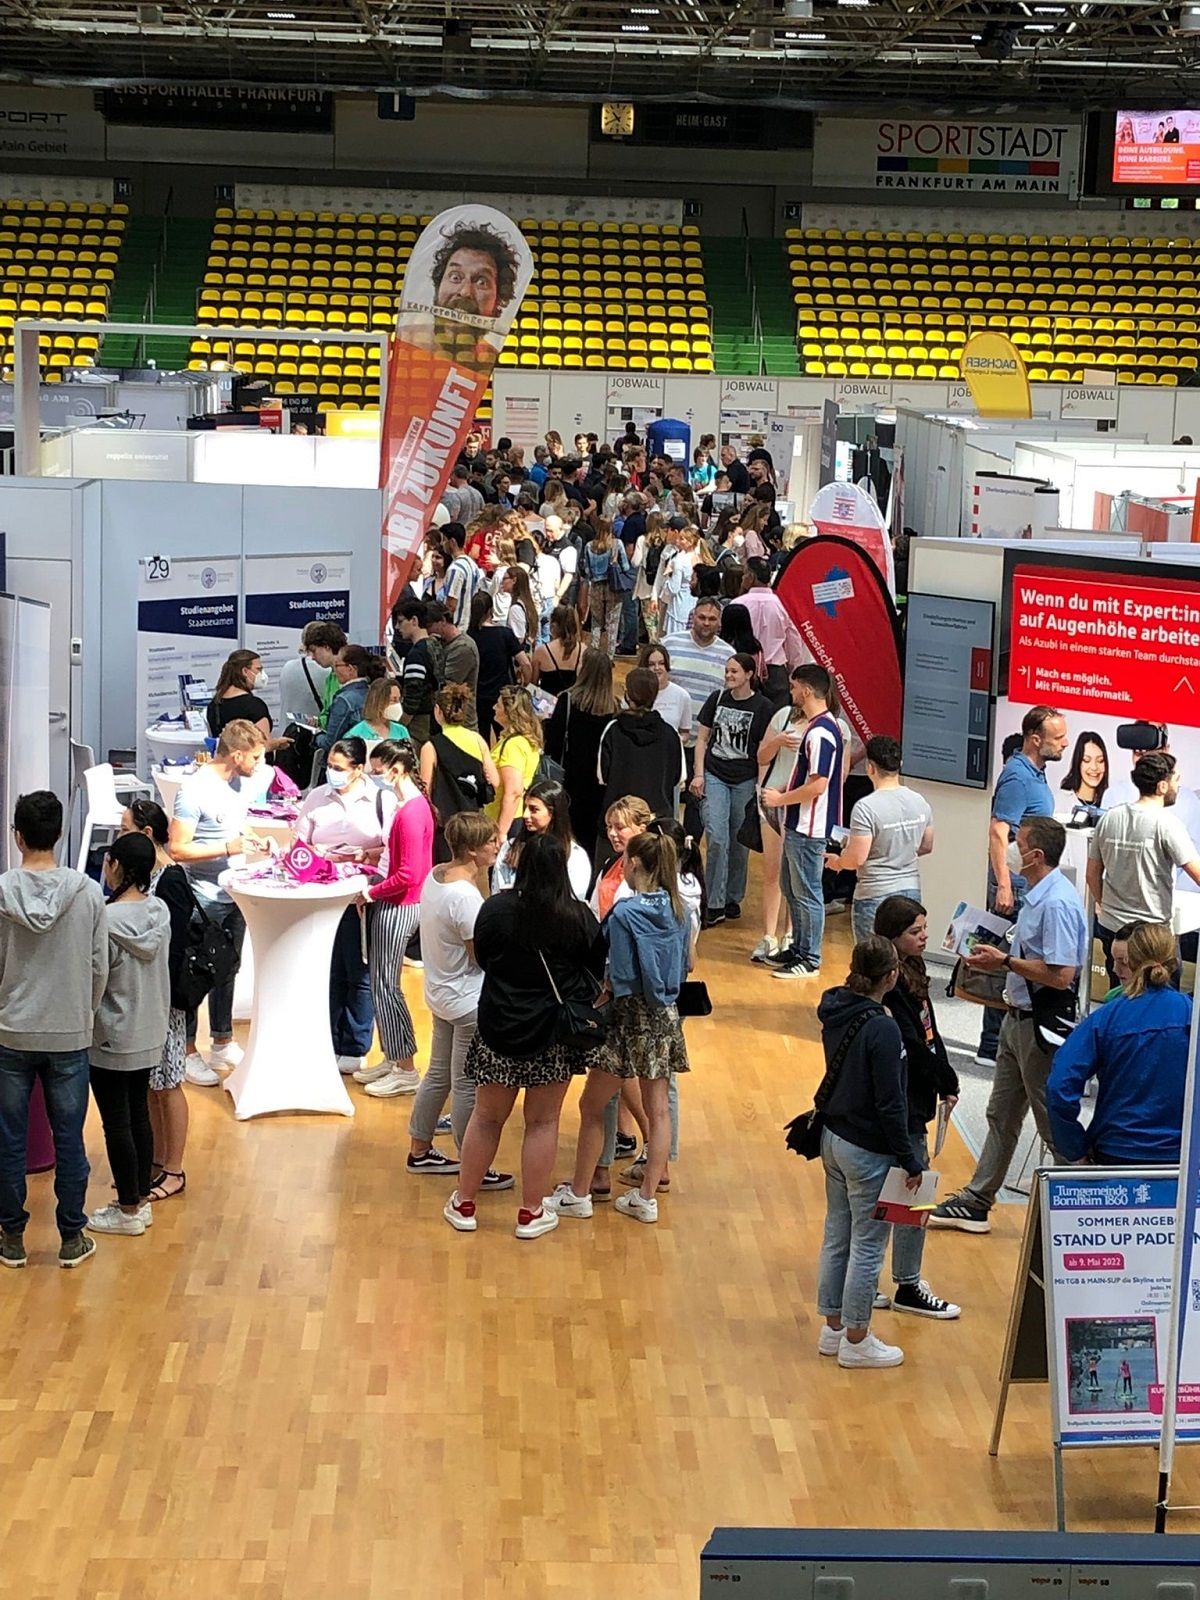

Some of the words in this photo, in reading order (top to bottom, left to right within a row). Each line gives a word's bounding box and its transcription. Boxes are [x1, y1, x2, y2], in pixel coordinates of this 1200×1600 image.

[114, 85, 232, 98] EISSPORTHALLE
[238, 88, 325, 102] FRANKFURT
[28, 140, 68, 153] Gebiet
[877, 123, 1068, 158] SPORTSTADT
[119, 183, 127, 192] H
[876, 175, 974, 189] FRANKFURT
[982, 179, 1006, 190] AM
[1015, 180, 1060, 192] MAIN
[789, 204, 796, 216] J
[611, 377, 660, 389] JOBWALL
[725, 380, 774, 392] JOBWALL
[838, 384, 888, 395] JOBWALL
[1066, 389, 1115, 401] JOBWALL
[402, 368, 477, 505] ZUKUNFT
[381, 502, 425, 560] ABI
[148, 559, 170, 579] 29
[289, 599, 345, 610] Studienangebot
[1020, 588, 1064, 608] Wenn
[1068, 593, 1088, 611] du
[1093, 597, 1120, 615] mit
[180, 603, 234, 616] Studienangebot
[315, 611, 345, 621] Bachelor
[188, 617, 234, 628] Staatsexamen
[1019, 612, 1044, 628] auf
[1046, 614, 1137, 640] Augenhöhe
[1141, 626, 1200, 646] arbeite
[800, 620, 837, 674] Hessische
[1018, 636, 1032, 646] Als
[1034, 637, 1058, 650] Azubi
[1060, 641, 1069, 650] in
[1070, 643, 1097, 654] einem
[1098, 644, 1132, 659] starken
[1134, 649, 1157, 661] Team
[1036, 667, 1059, 679] Mach
[1061, 671, 1071, 680] es
[1073, 670, 1112, 686] möglich.
[1035, 680, 1050, 690] Mit
[1051, 681, 1081, 695] Finanz
[1082, 684, 1133, 702] Informatik.
[1055, 1184, 1128, 1198] Turngemeinde
[1053, 1195, 1103, 1206] Bornheim
[1104, 1195, 1129, 1206] 1860
[1078, 1217, 1130, 1227] SOMMER
[1133, 1216, 1177, 1226] ANGEB
[1053, 1233, 1107, 1247] STAND
[1111, 1233, 1132, 1246] UP
[1068, 1259, 1078, 1267] ab
[1079, 1258, 1087, 1266] 9.
[1087, 1257, 1100, 1266] Mai
[1102, 1257, 1121, 1266] 2022
[1132, 1276, 1154, 1285] Skyline
